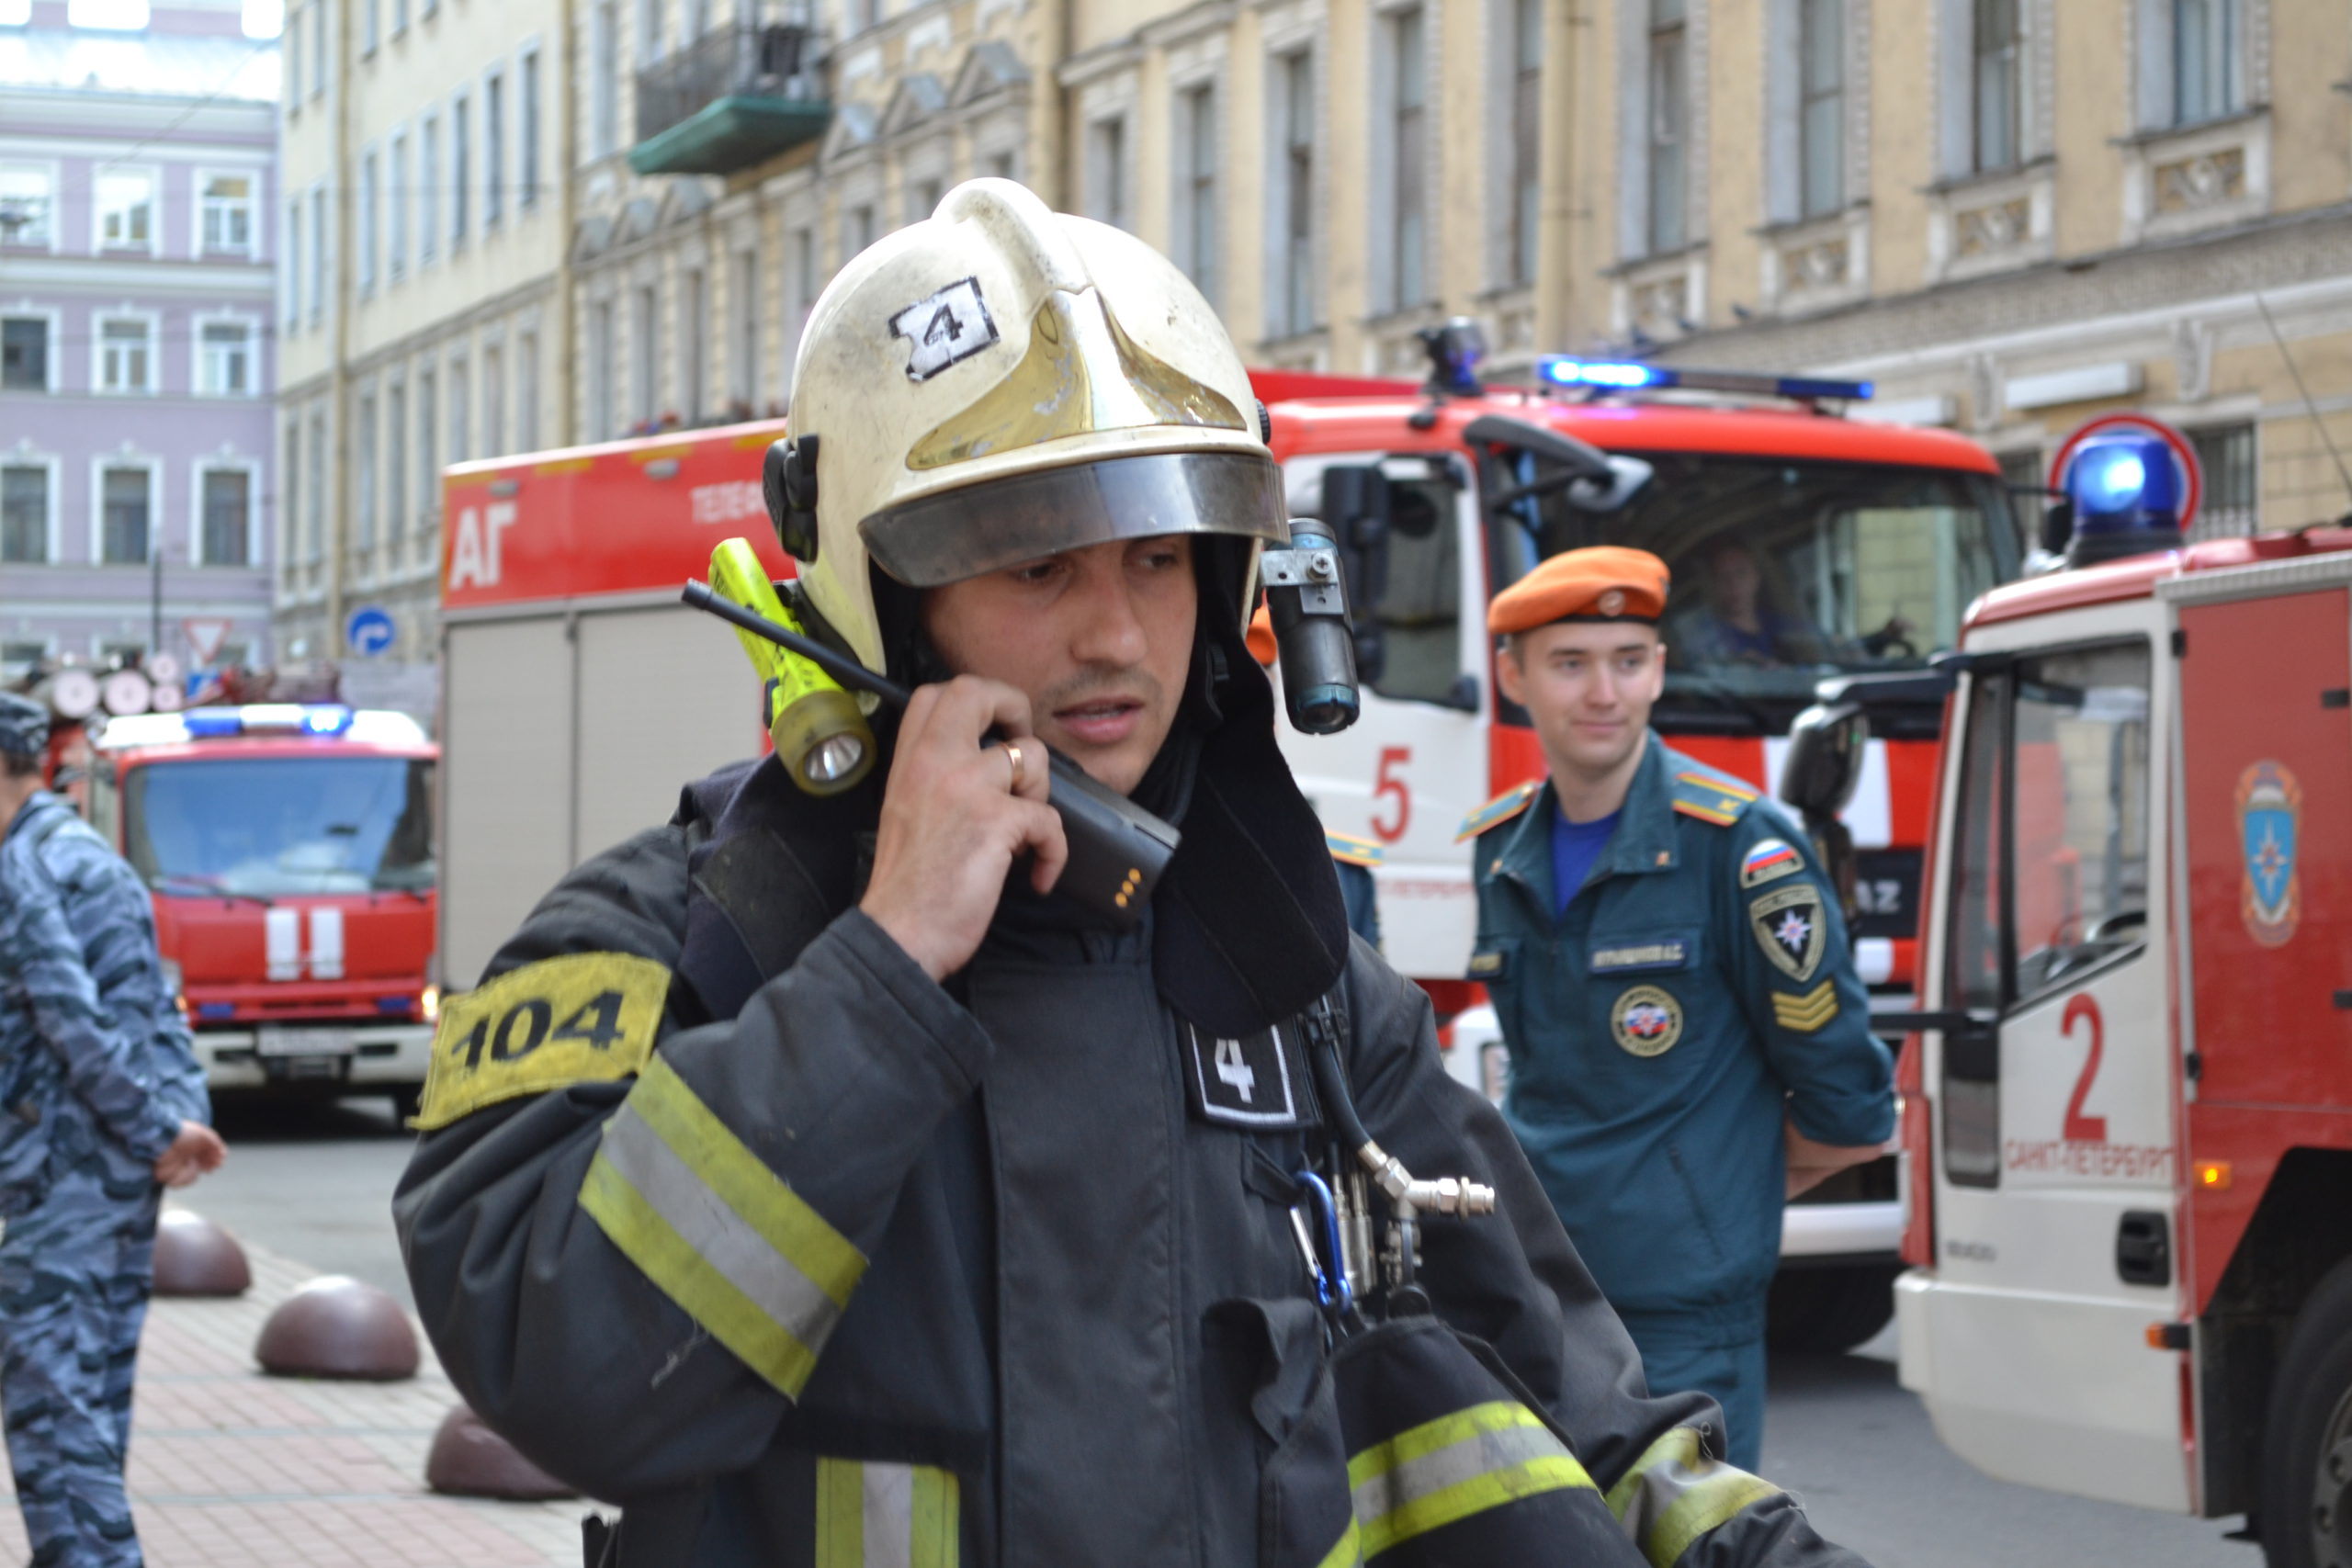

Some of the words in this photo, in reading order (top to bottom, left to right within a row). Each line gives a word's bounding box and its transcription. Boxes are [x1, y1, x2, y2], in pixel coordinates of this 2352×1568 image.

[923, 303, 964, 345] 4
[449, 502, 517, 591] АГ
[1370, 746, 1411, 842] 5
[451, 989, 625, 1073] 104
[1215, 1039, 1255, 1102] 4
[2061, 993, 2106, 1141] 2
[2006, 1139, 2176, 1177] САНКТ-ПЕТЕРБУРГ
